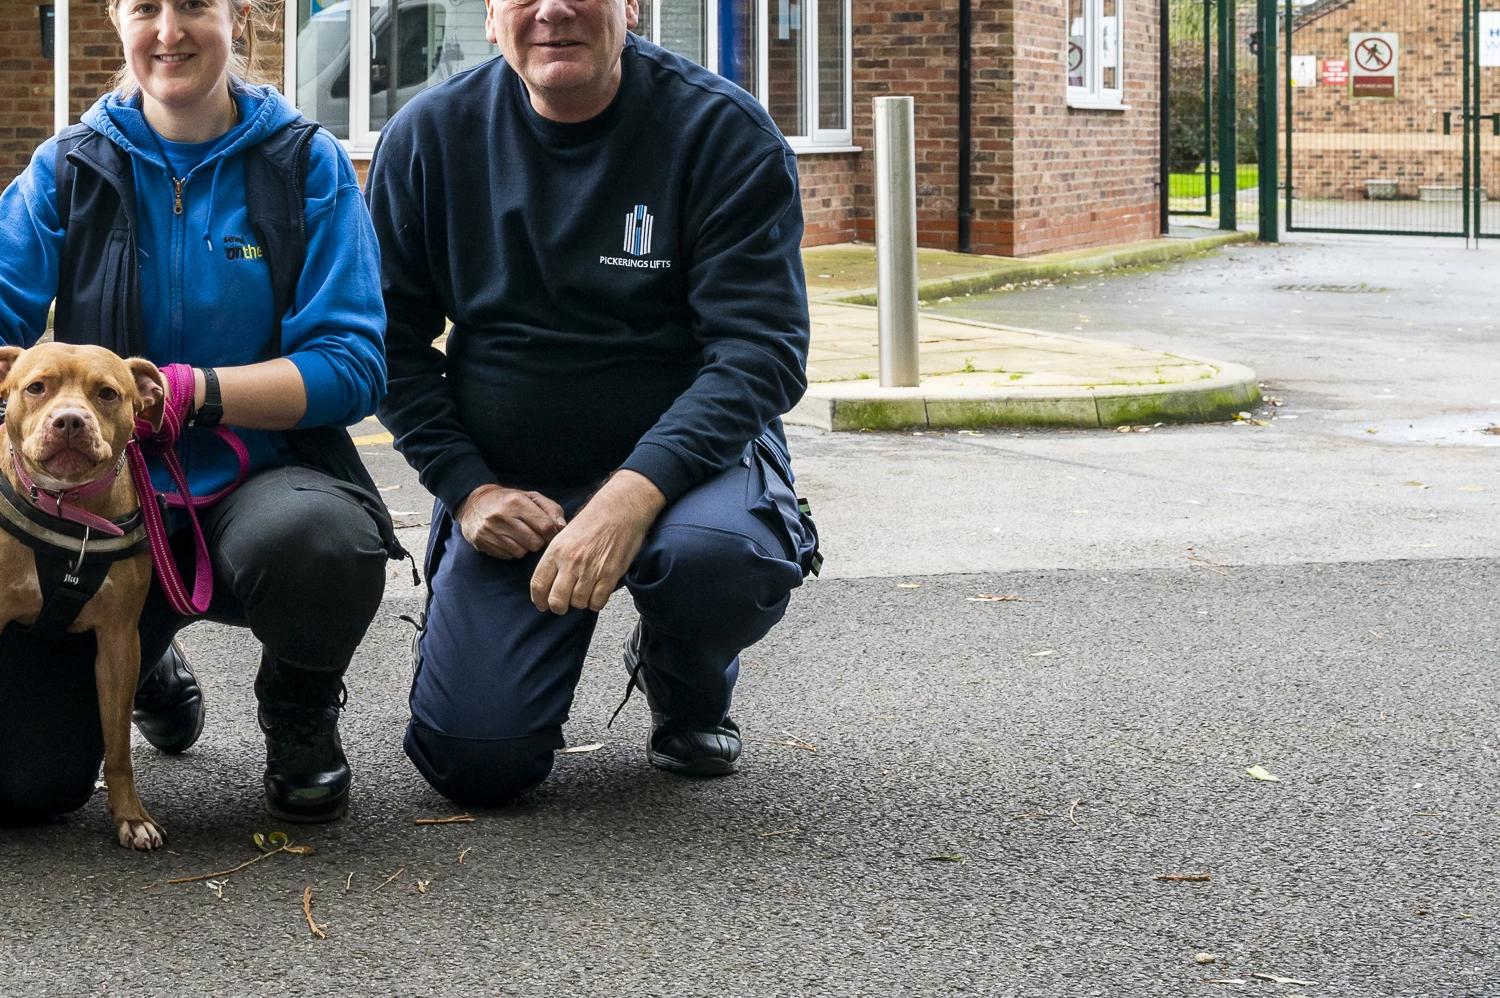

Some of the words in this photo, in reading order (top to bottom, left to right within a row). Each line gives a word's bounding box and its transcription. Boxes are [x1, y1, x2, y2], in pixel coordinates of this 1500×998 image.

[225, 243, 262, 260] onthe
[599, 255, 648, 268] PICKERINGS
[649, 260, 671, 269] LIFTS
